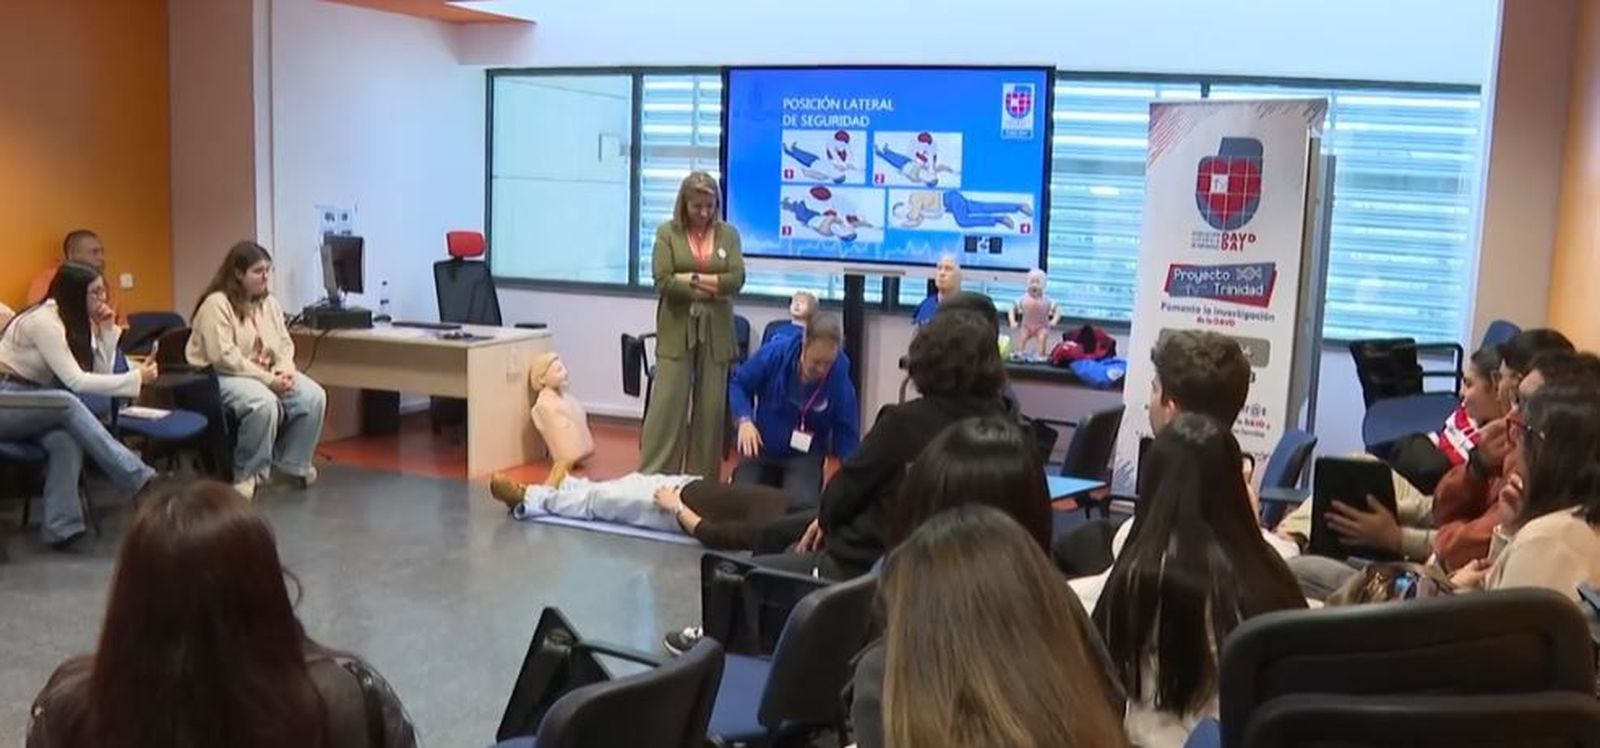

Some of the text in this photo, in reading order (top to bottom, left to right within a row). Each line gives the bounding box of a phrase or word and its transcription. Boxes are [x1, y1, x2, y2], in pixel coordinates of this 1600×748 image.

[783, 96, 894, 111] POSICIÓN LATERAL
[783, 114, 870, 127] DE SEGURIDAD
[1174, 268, 1230, 283] Proyecto
[1214, 283, 1264, 296] Trinidad
